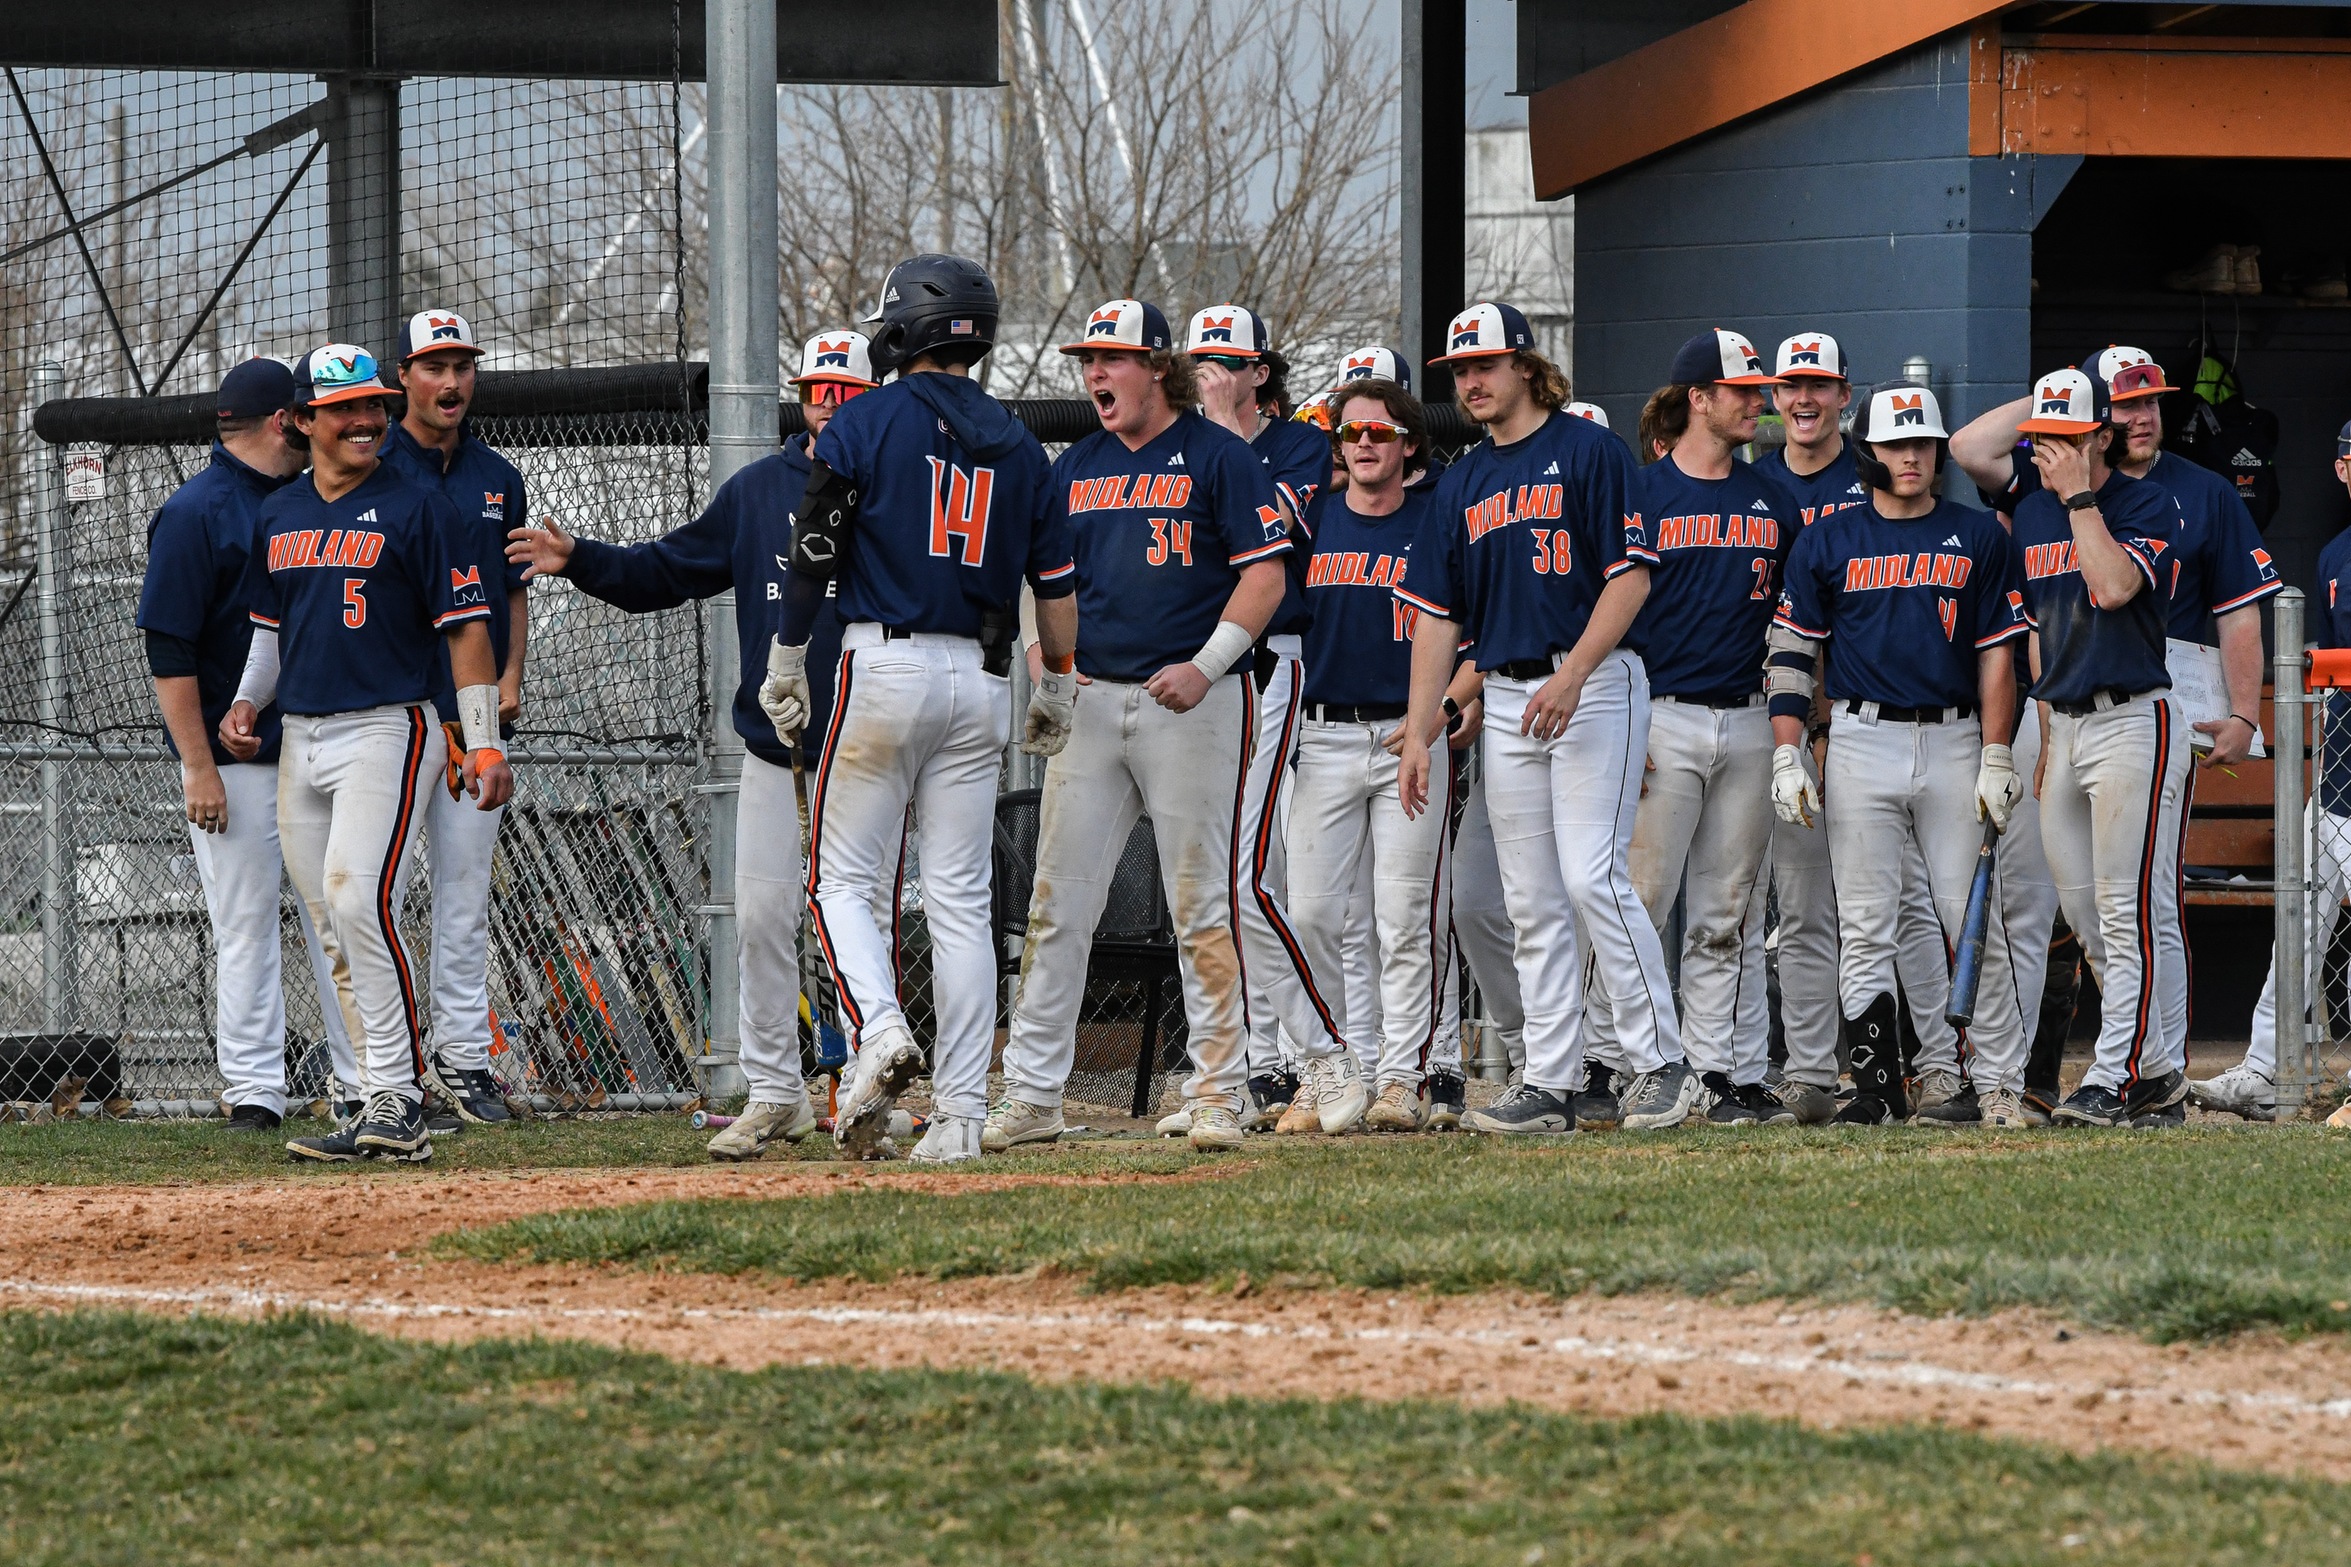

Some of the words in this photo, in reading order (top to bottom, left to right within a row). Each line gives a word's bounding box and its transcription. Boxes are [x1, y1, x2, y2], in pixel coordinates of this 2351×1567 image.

[429, 317, 462, 340] M
[1087, 310, 1121, 337] M
[1200, 317, 1234, 342] M
[1452, 319, 1480, 350] M
[814, 340, 851, 368] M
[1789, 342, 1821, 365] M
[1890, 394, 1925, 427] M
[2040, 387, 2073, 415] M
[66, 455, 102, 476] ELKHORN
[2231, 459, 2262, 467] adidas
[925, 455, 994, 568] 14
[1069, 474, 1193, 516] MIDLAND
[268, 529, 385, 573] MIDLAND
[1147, 518, 1193, 566] 34
[1530, 529, 1571, 575] 38
[1657, 514, 1779, 552] MIDLAND
[1844, 552, 1972, 592] MIDLAND
[2025, 538, 2081, 581] MIDLA
[344, 578, 366, 629] 5
[451, 565, 485, 605] M
[1938, 596, 1957, 642] 4
